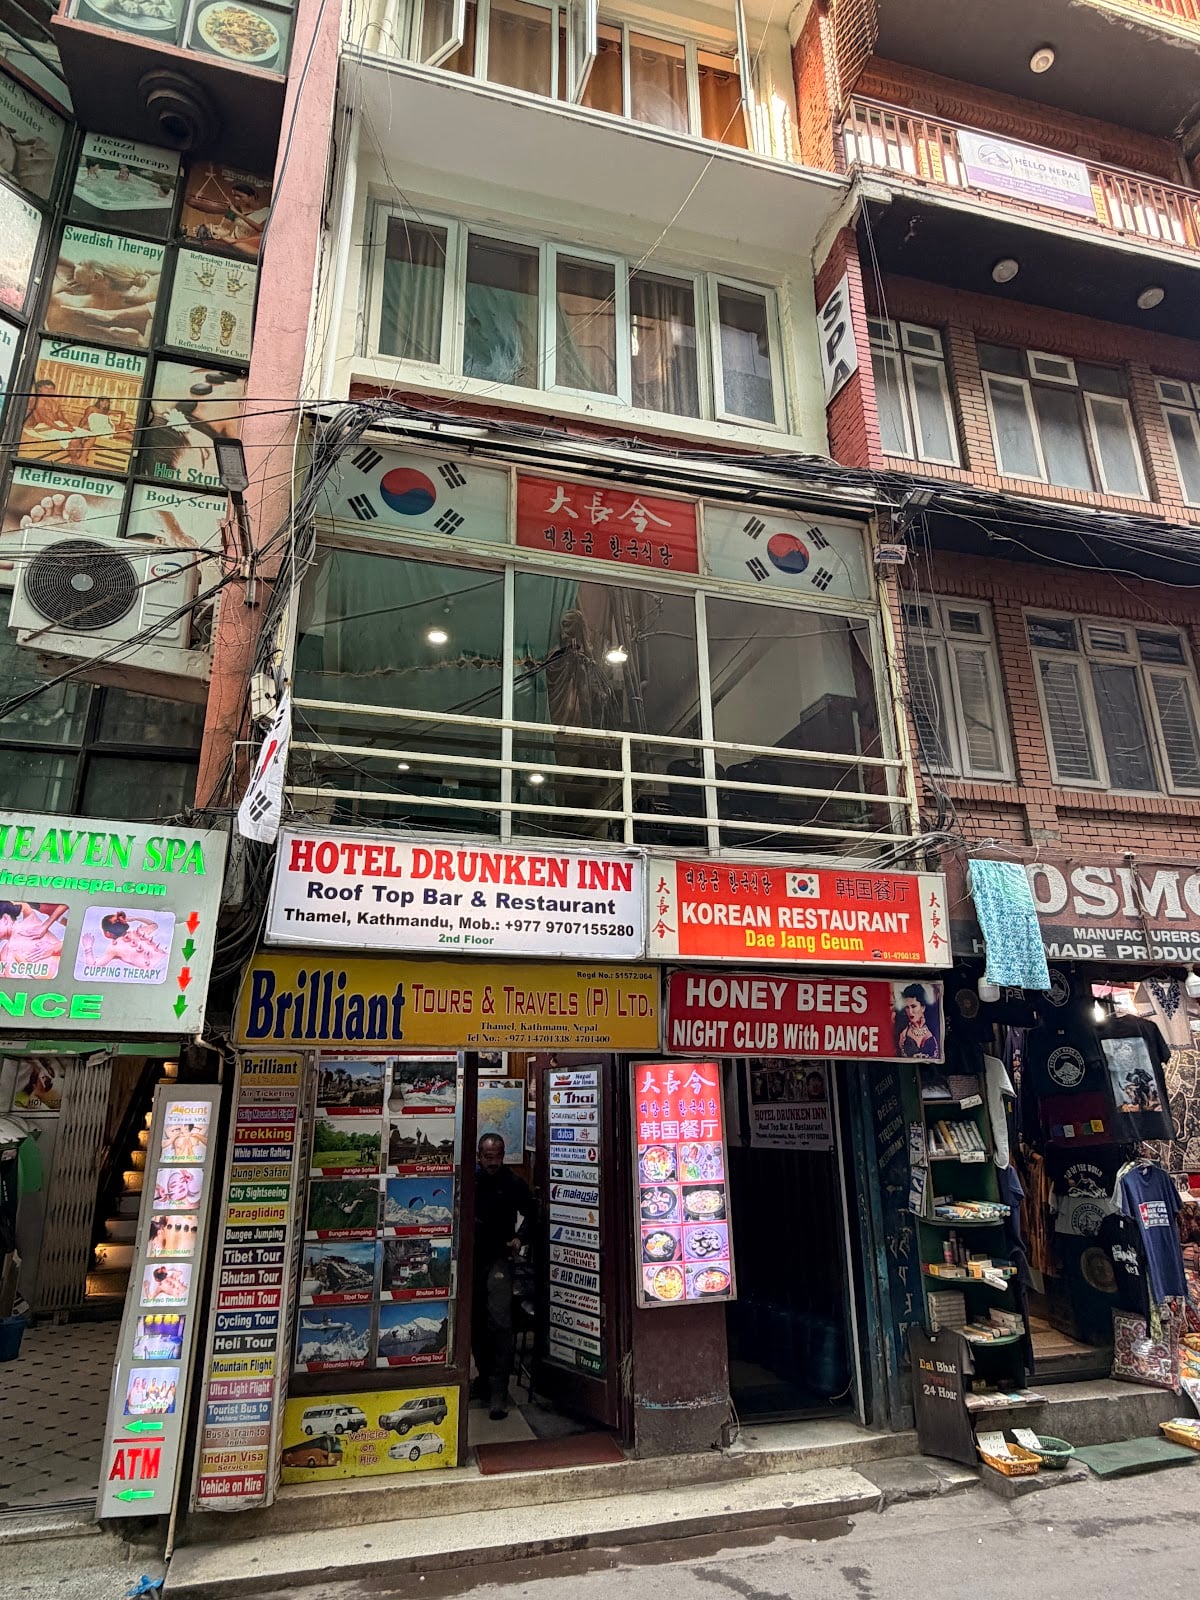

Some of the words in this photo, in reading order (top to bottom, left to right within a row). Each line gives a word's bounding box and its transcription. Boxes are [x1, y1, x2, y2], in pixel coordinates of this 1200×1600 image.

[94, 136, 136, 151] Jacuzzi
[92, 145, 171, 171] Hydrotherapy
[1014, 157, 1047, 172] HELLO
[1048, 166, 1081, 182] NEPAL
[64, 226, 114, 249] Swedish
[117, 236, 164, 261] Therapy
[190, 252, 223, 267] Reflexology
[225, 260, 242, 269] Hand
[178, 339, 213, 352] Reflexology
[215, 346, 229, 355] Foot
[230, 349, 249, 358] Chart
[823, 289, 851, 399] SPA
[50, 341, 100, 365] Sauna
[104, 352, 142, 373] Bath
[154, 463, 181, 481] Hot
[20, 467, 115, 496] Reflexology
[146, 490, 183, 505] Body
[544, 485, 672, 533] 大長今
[544, 526, 594, 553] 대장금
[608, 535, 673, 566] 한국식당
[143, 836, 206, 875] SPA
[288, 840, 401, 878] HOTEL
[411, 848, 570, 887] DRUNKEN
[578, 860, 633, 892] INN
[685, 869, 720, 893] 대장금
[728, 870, 773, 896] 한국식당
[835, 878, 910, 903] 韩国餐厅
[307, 882, 364, 901] Roof
[372, 886, 414, 908] Top
[423, 888, 463, 907] Bar
[470, 891, 486, 908] &
[495, 892, 616, 915] Restaurant
[651, 877, 676, 939] 大長今
[284, 909, 351, 926] Thamel,
[357, 912, 454, 931] Kathmandu,
[459, 917, 500, 930] Mob.:
[505, 920, 540, 933] +977
[546, 921, 634, 937] 9707155280
[682, 902, 771, 928] KOREAN
[778, 907, 910, 934] RESTAURANT
[927, 892, 949, 950] 大長今
[438, 933, 461, 944] 2nd
[464, 935, 494, 945] Floor
[746, 930, 775, 948] Dae
[780, 931, 816, 953] Jang
[820, 932, 864, 951] Geum
[883, 951, 920, 961] 01-4700123
[1047, 943, 1107, 959] MADE
[10, 962, 49, 975] SCRUB
[84, 967, 121, 978] CUPPING
[123, 968, 161, 980] THERAPY
[577, 972, 596, 980] Regd
[686, 978, 788, 1011] HONEY
[797, 983, 868, 1015] BEES
[245, 970, 405, 1041] Brilliant
[411, 983, 473, 1014] TOURS
[481, 986, 495, 1014] &
[503, 986, 578, 1016] TRAVELS
[586, 987, 609, 1017] (P)
[617, 988, 654, 1017] LTD.
[481, 1022, 517, 1032] Thamel,
[520, 1022, 570, 1032] Kathmanu,
[573, 1023, 598, 1033] Nepal
[467, 1034, 480, 1042] Tel
[482, 1034, 501, 1042] No.:
[574, 1035, 611, 1043] 4701400
[673, 1019, 729, 1048] NIGHT
[733, 1021, 778, 1050] CLUB
[783, 1022, 819, 1051] With
[825, 1025, 879, 1053] DANCE
[243, 1058, 298, 1074] Brilliant
[640, 1069, 716, 1096] 大長今
[256, 1090, 295, 1098] Ticketing
[564, 1092, 594, 1104] Thai
[754, 1109, 776, 1121] HOTEL
[776, 1107, 811, 1121] DRUNKEN
[812, 1107, 827, 1120] INN
[237, 1127, 292, 1141] Trekking
[640, 1119, 718, 1140] 韩国餐厅
[234, 1147, 251, 1158] White
[252, 1147, 269, 1158] Water
[270, 1147, 290, 1159] Rafting
[232, 1168, 261, 1180] Jungle
[263, 1166, 289, 1178] Safari
[230, 1187, 245, 1200] City
[246, 1186, 287, 1200] Sightseeing
[563, 1189, 598, 1202] malaysia
[229, 1207, 285, 1220] Paragliding
[226, 1229, 253, 1242] Bungee
[254, 1227, 284, 1241] Jumping
[224, 1249, 253, 1263] Tibet
[256, 1249, 281, 1262] Tour
[563, 1248, 596, 1261] SICHUAN
[563, 1257, 597, 1269] AIRLINES
[221, 1271, 255, 1285] Bhutan
[258, 1270, 280, 1283] Tour
[561, 1270, 573, 1282] AIR
[574, 1272, 598, 1289] CHINA
[219, 1292, 256, 1307] Lumbini
[257, 1291, 278, 1305] Tour
[217, 1315, 252, 1329] Cycling
[254, 1313, 276, 1325] Tour
[551, 1307, 574, 1326] IndiGo
[215, 1337, 241, 1351] Heli
[244, 1336, 274, 1349] Tour
[212, 1360, 248, 1374] Mountain
[250, 1359, 272, 1373] Flight
[410, 1355, 431, 1363] Cycling
[919, 1358, 934, 1371] Dal
[936, 1361, 957, 1374] Bhat
[210, 1383, 228, 1396] Ultra
[229, 1382, 248, 1397] Light
[249, 1381, 270, 1396] Flight
[923, 1384, 937, 1395] 24
[938, 1386, 958, 1400] Hour
[208, 1404, 239, 1415] Tourist
[240, 1403, 257, 1414] Bus
[259, 1402, 268, 1413] to
[206, 1430, 222, 1439] Bus
[224, 1429, 230, 1438] &
[234, 1428, 254, 1438] Train
[256, 1427, 265, 1437] to
[349, 1430, 389, 1441] Vehicles
[360, 1444, 374, 1453] on
[109, 1447, 162, 1481] ATM
[203, 1453, 237, 1464] Indian
[240, 1451, 264, 1462] Visa
[360, 1455, 379, 1465] Hire
[200, 1479, 230, 1495] Vehicle
[231, 1480, 242, 1492] on
[244, 1477, 262, 1491] Hire
